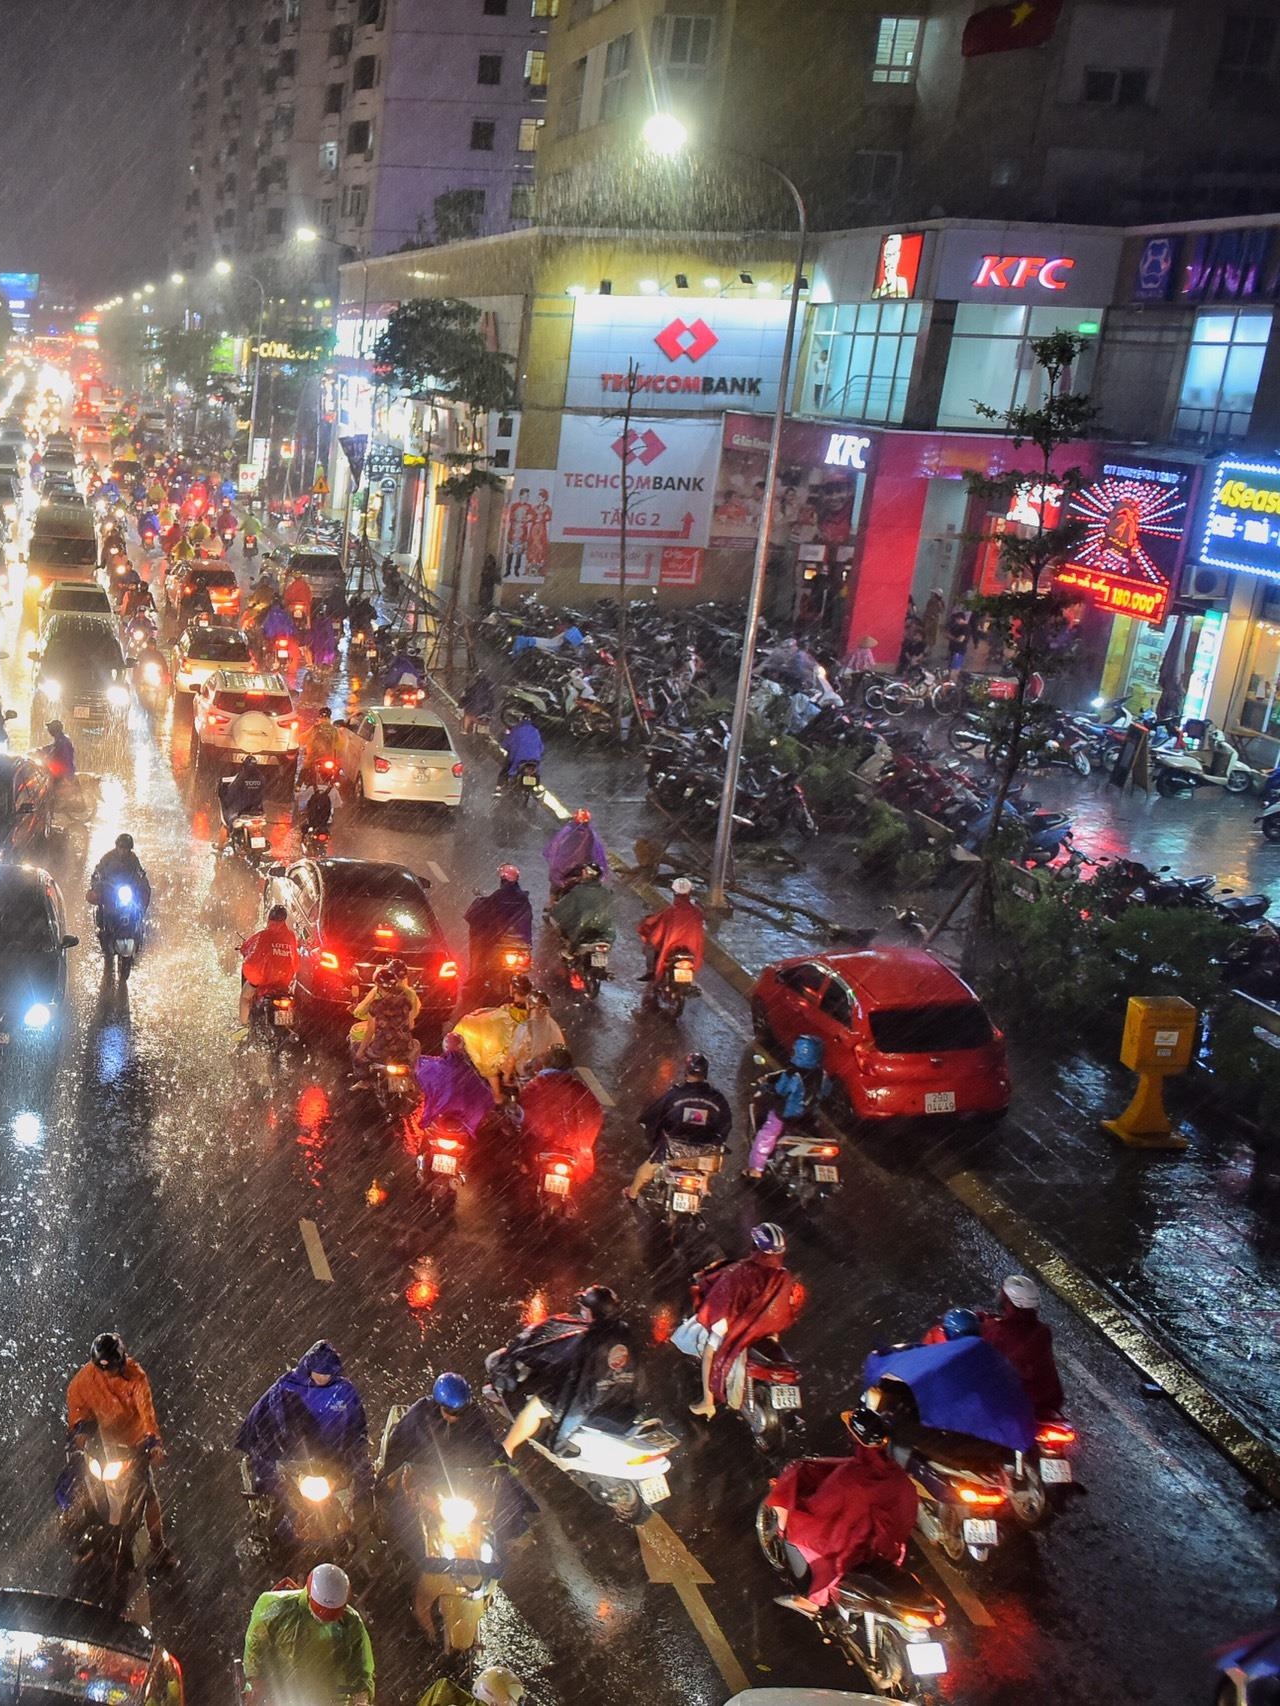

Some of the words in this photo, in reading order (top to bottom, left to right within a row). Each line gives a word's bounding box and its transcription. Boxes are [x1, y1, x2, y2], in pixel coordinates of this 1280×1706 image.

[972, 254, 1075, 290] KFC
[601, 373, 761, 397] TECHCOMBANK
[824, 434, 871, 469] KFC
[563, 473, 704, 492] TECHCOMBANK
[650, 513, 661, 526] 2
